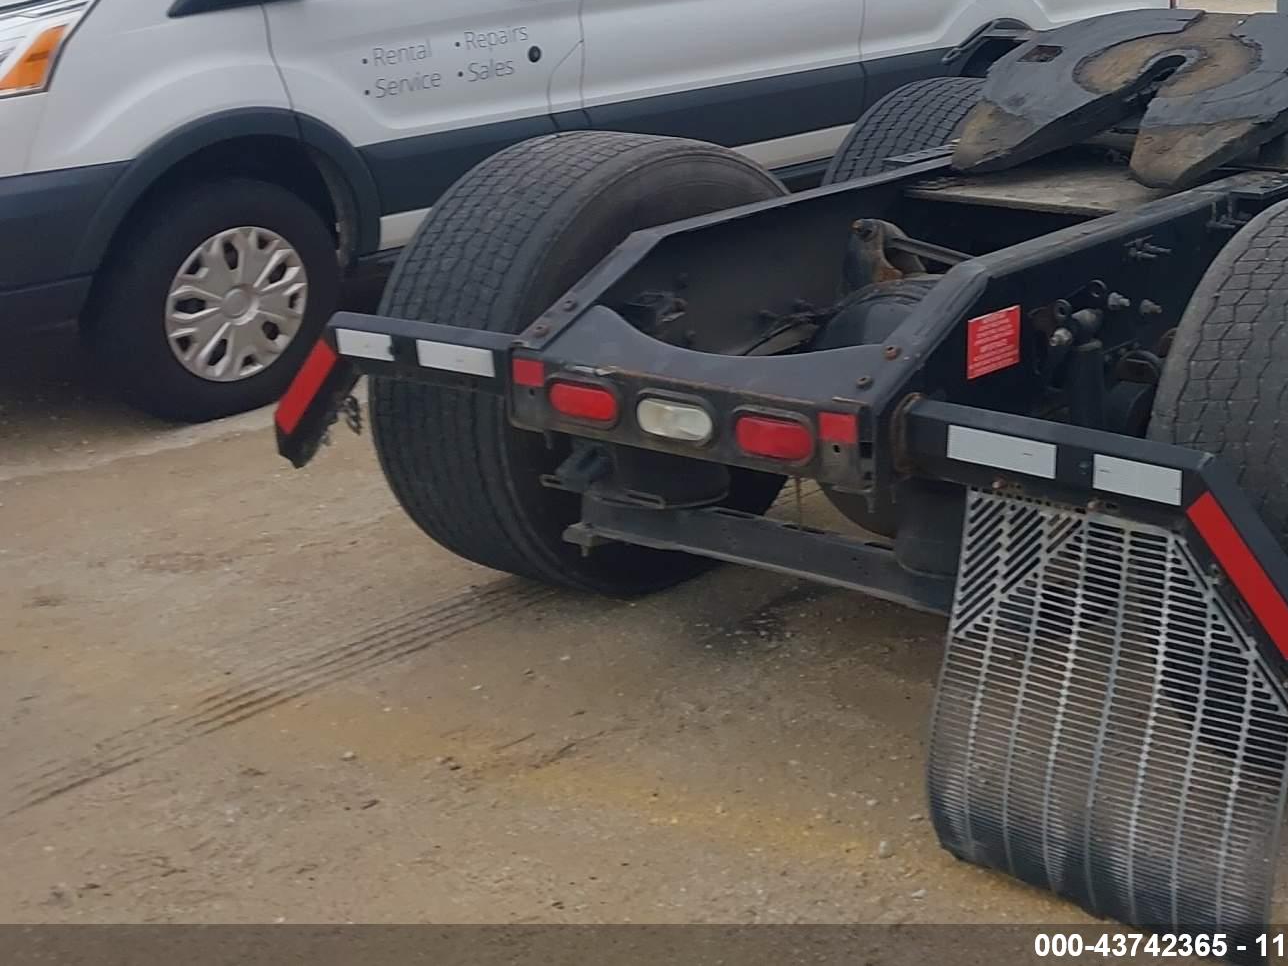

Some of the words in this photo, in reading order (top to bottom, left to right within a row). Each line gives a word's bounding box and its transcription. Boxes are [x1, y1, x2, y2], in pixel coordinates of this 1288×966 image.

[373, 39, 432, 66] Rental
[464, 26, 529, 52] Repairs
[375, 72, 441, 98] Service
[467, 59, 515, 82] Sales
